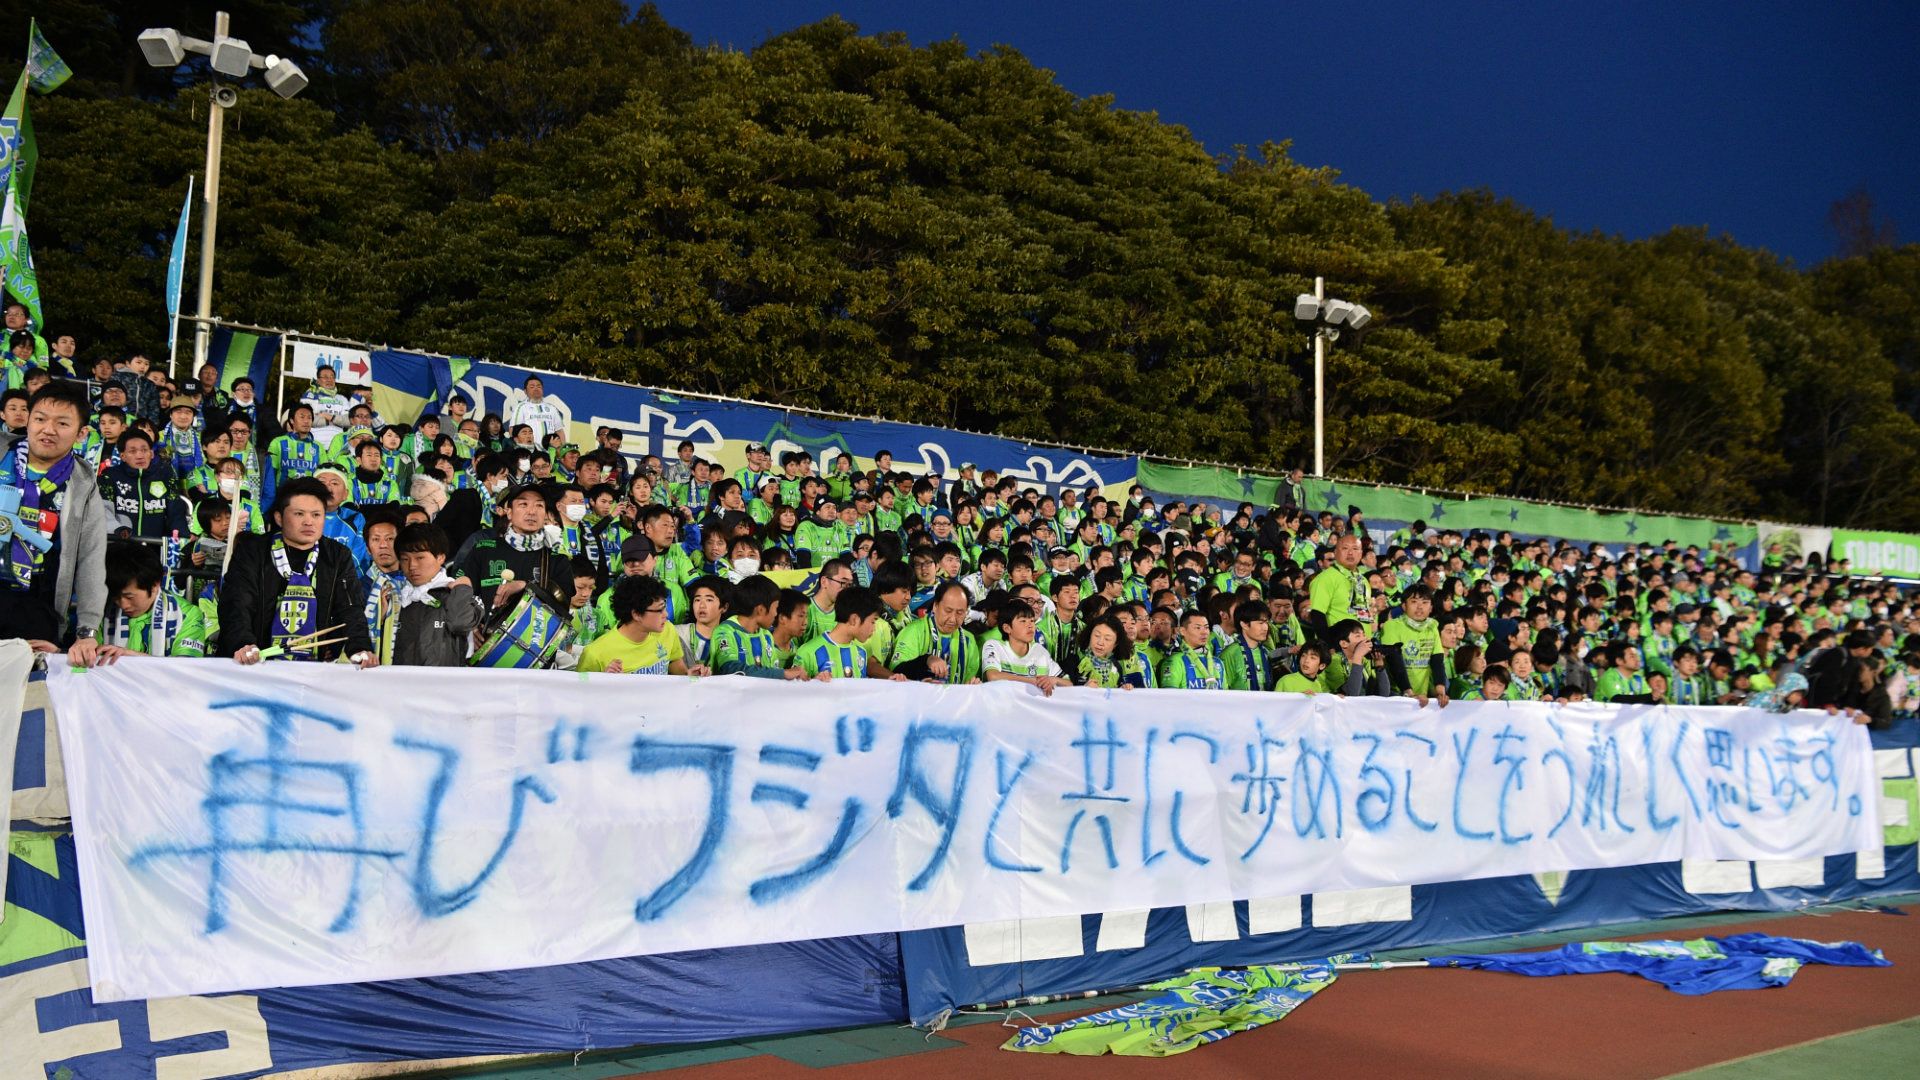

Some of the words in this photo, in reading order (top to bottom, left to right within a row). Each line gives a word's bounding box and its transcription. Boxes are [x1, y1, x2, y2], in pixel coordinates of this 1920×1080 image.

[126, 699, 1862, 936] 再びフジタと共に歩めることをうれしく思います。
